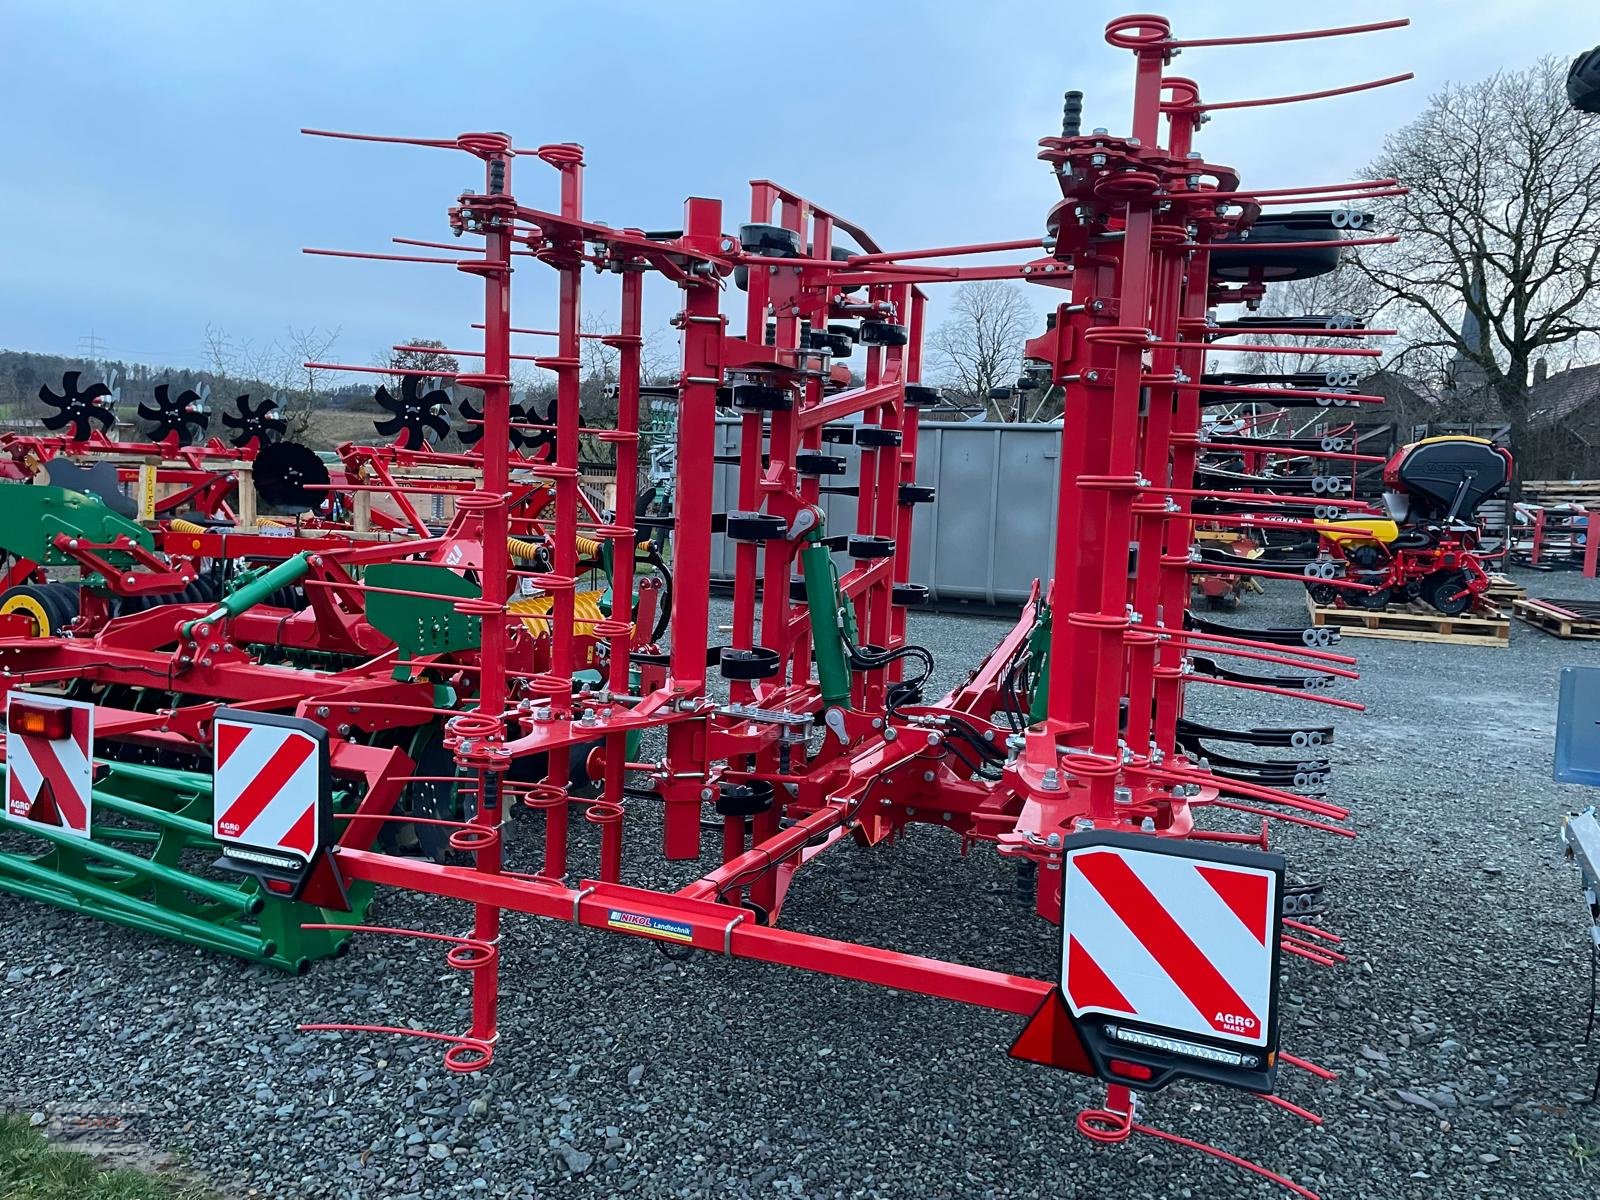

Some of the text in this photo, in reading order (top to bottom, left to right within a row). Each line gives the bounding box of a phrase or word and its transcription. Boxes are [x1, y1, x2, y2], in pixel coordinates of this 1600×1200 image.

[10, 799, 30, 810] AGRO
[220, 821, 240, 831] AGRO
[621, 912, 652, 927] NIKOL
[653, 921, 690, 935] Landtechnik
[1214, 1011, 1255, 1028] AGRO
[1223, 1023, 1246, 1033] MASZ
